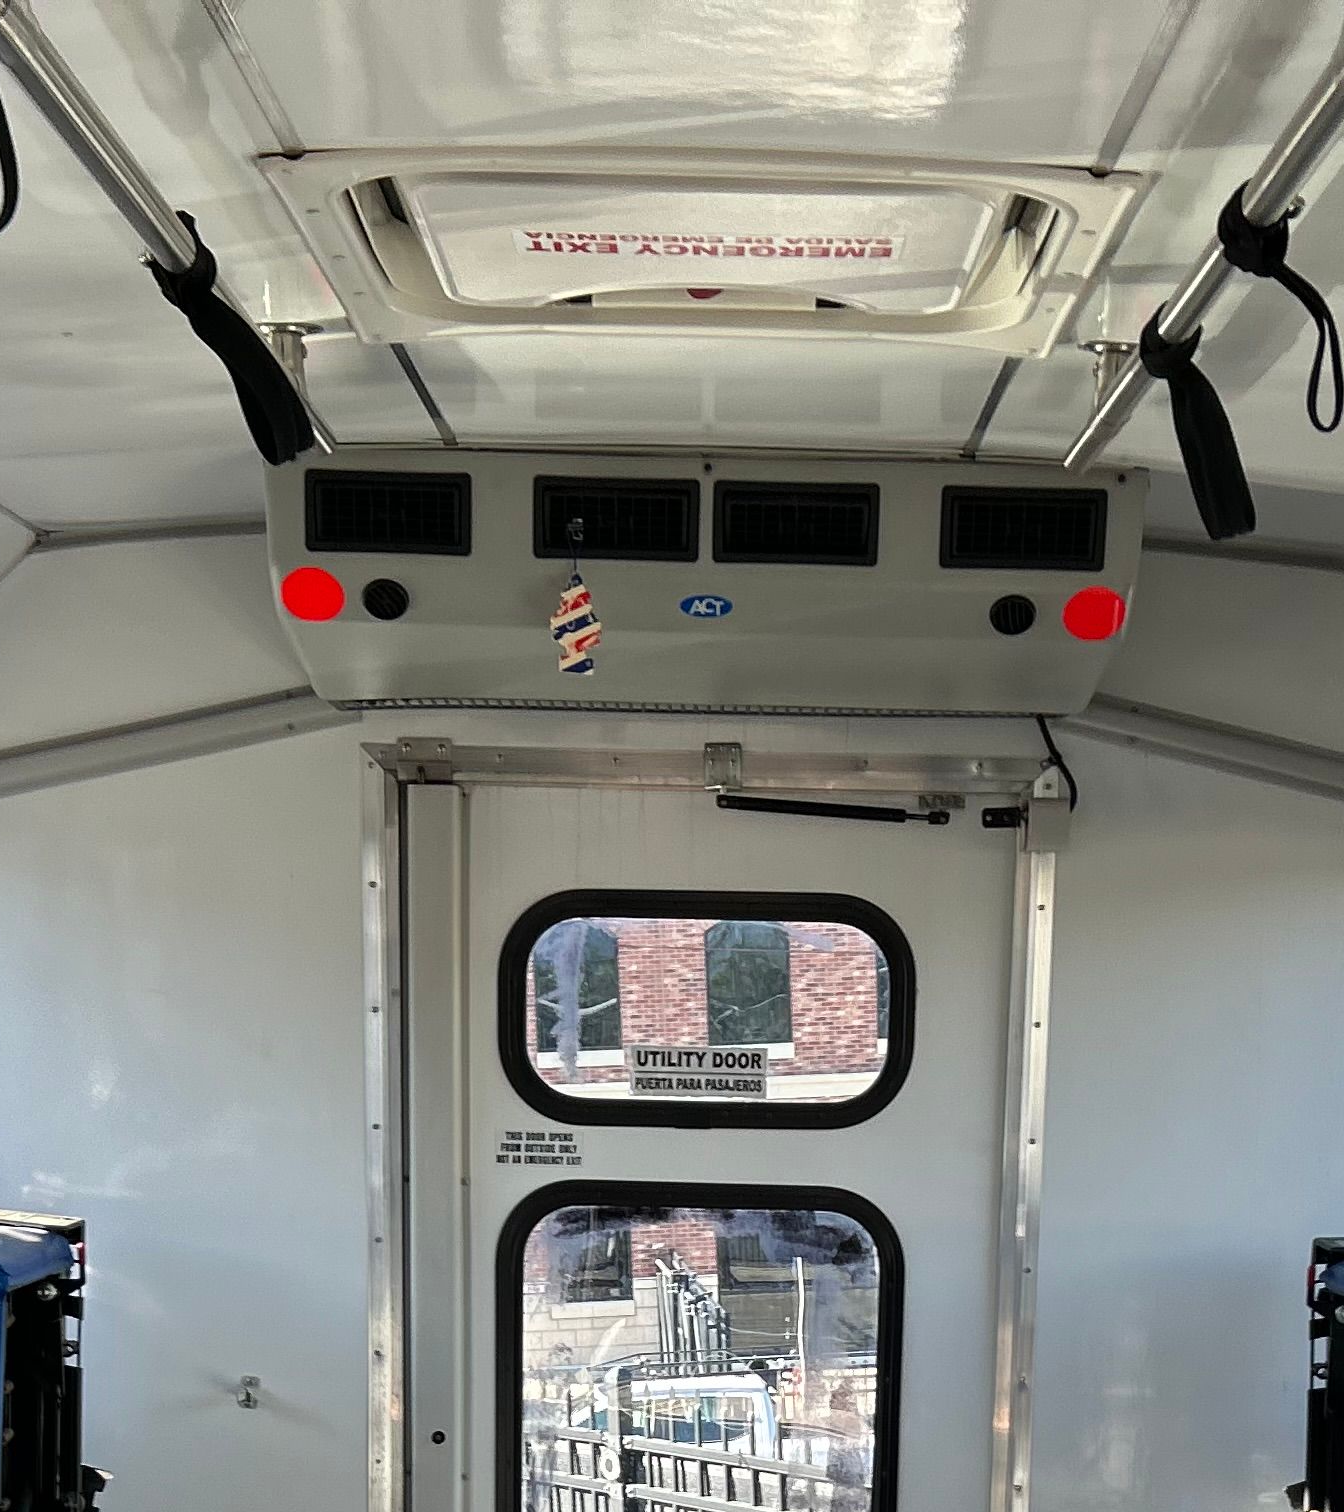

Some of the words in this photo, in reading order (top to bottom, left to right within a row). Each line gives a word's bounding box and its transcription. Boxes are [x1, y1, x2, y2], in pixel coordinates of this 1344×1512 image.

[525, 230, 723, 243] EMERGENCIA
[735, 235, 774, 245] DE
[785, 236, 892, 246] SALIDA
[526, 240, 619, 255] EXIT
[638, 244, 892, 258] EMERGENCY
[689, 598, 725, 616] ACT
[637, 1050, 706, 1069] UTILITY
[711, 1051, 762, 1069] DOOR
[634, 1077, 674, 1091] PUERTA
[676, 1077, 702, 1091] PARA
[705, 1078, 762, 1093] PASAJEROS
